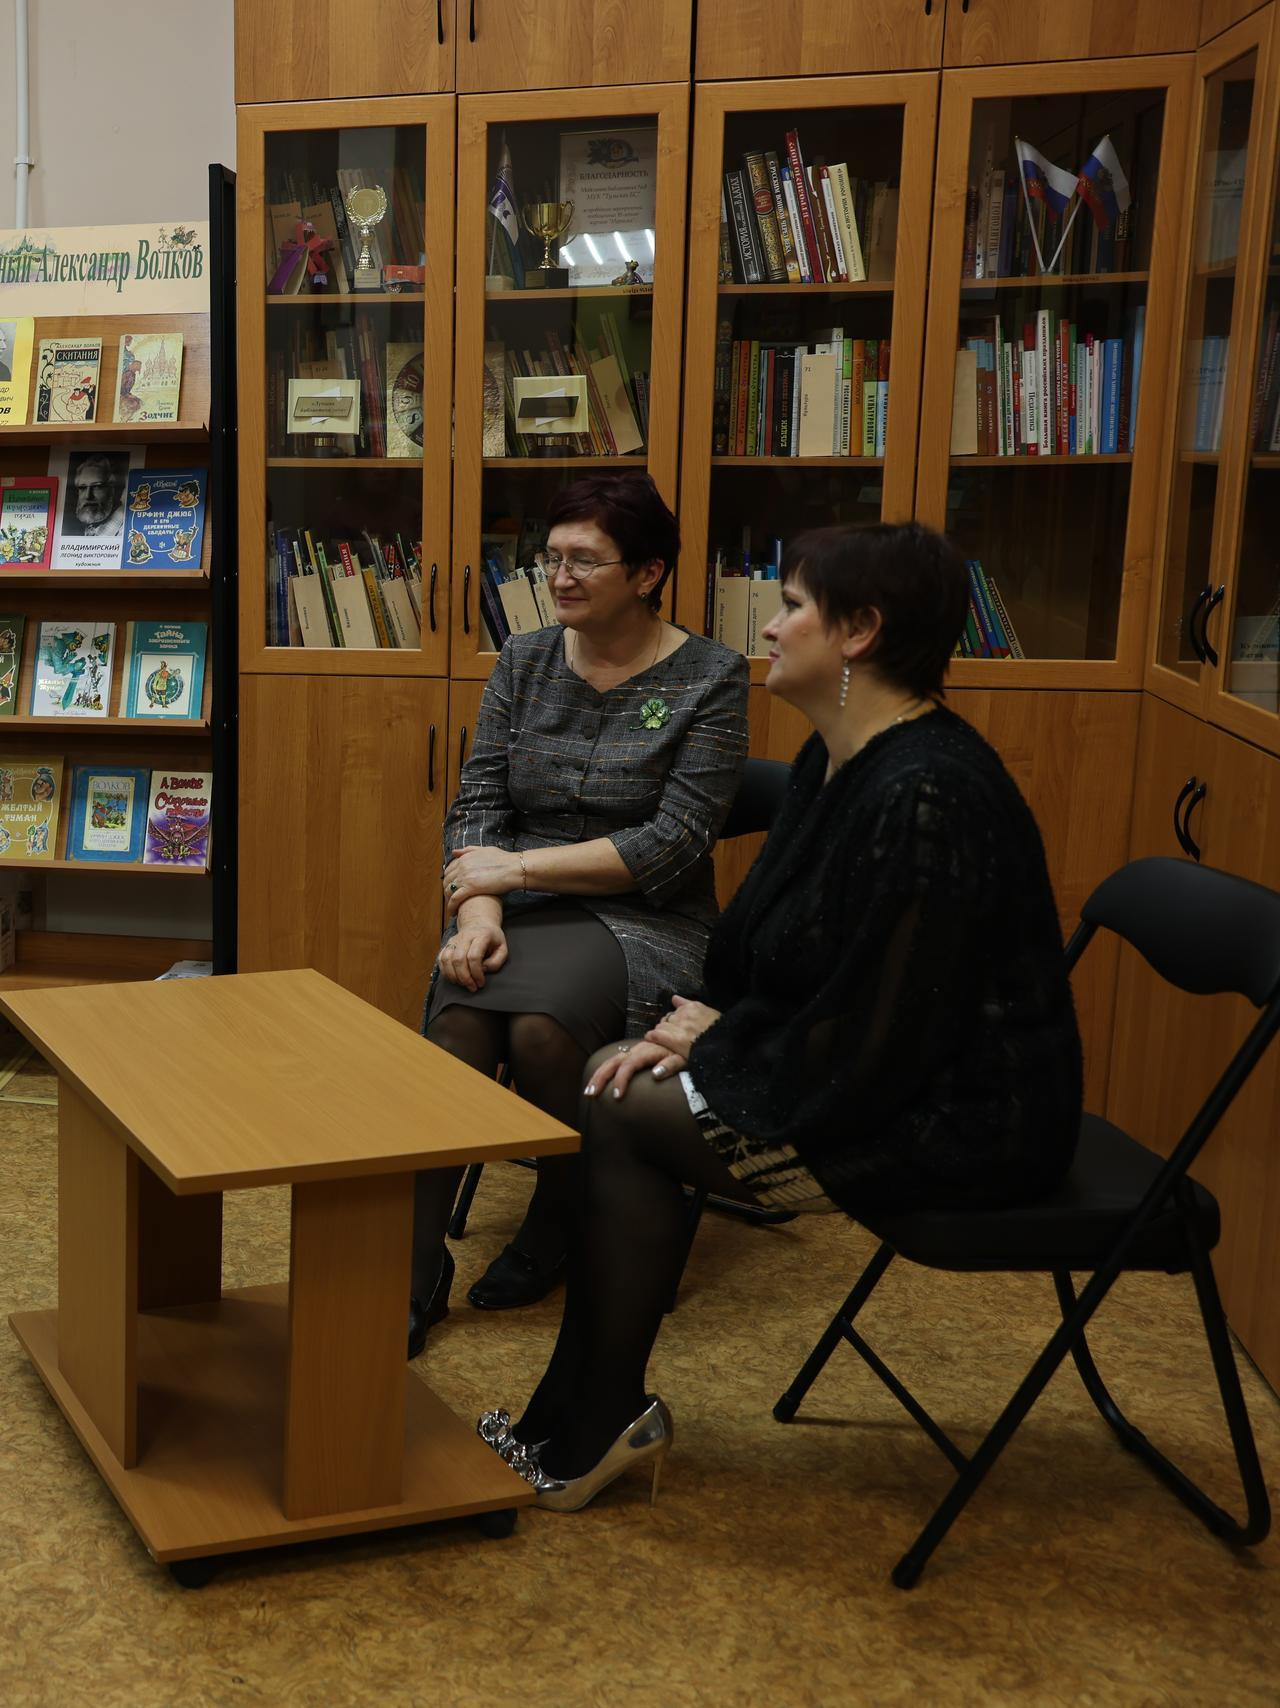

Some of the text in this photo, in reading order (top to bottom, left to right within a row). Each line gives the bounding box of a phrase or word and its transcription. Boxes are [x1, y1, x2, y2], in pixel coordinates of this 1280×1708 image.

[580, 168, 649, 180] БЛАГОДАРНОСТЬ
[738, 226, 754, 259] ИСТОРИЯ
[36, 248, 131, 293] Александр
[135, 239, 204, 281] Волков
[56, 350, 98, 361] СКИТАНИЯ
[867, 395, 875, 444] КУЛЬТУРОЛОГИЯ
[780, 419, 788, 448] ЕЛЬЦИН
[167, 511, 192, 519] ДЖЮС
[60, 543, 120, 551] ВЛАДИМИРСКИЙ
[93, 782, 131, 791] ВОЛКОВ
[1, 802, 43, 812] ЖЕЛТЫЙ
[4, 814, 37, 822] ТУМАН
